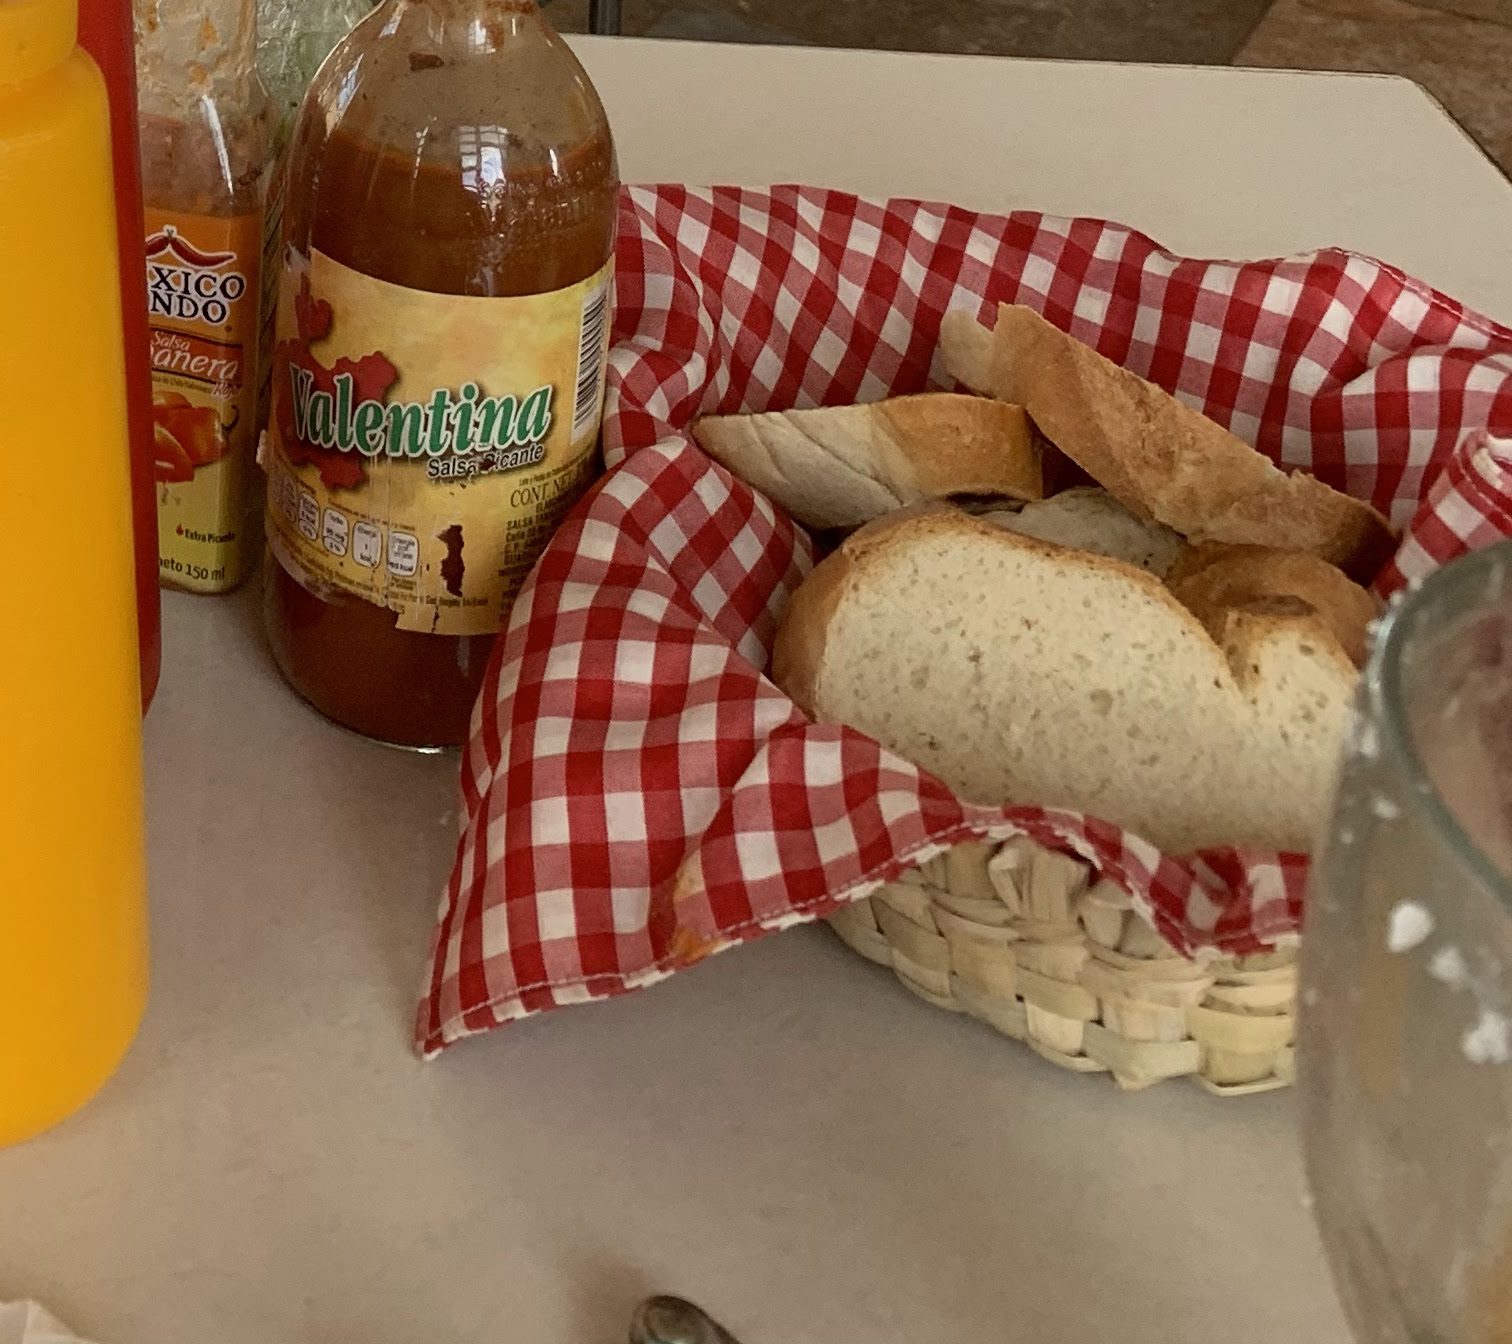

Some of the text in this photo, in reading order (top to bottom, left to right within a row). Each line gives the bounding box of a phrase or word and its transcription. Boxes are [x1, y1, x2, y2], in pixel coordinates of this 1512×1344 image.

[151, 266, 245, 300] XICO
[151, 290, 227, 323] NDO
[153, 330, 190, 352] Salsa
[150, 341, 238, 381] anera
[290, 361, 553, 457] Valentina
[427, 457, 478, 479] Salsa
[185, 562, 209, 580] 150
